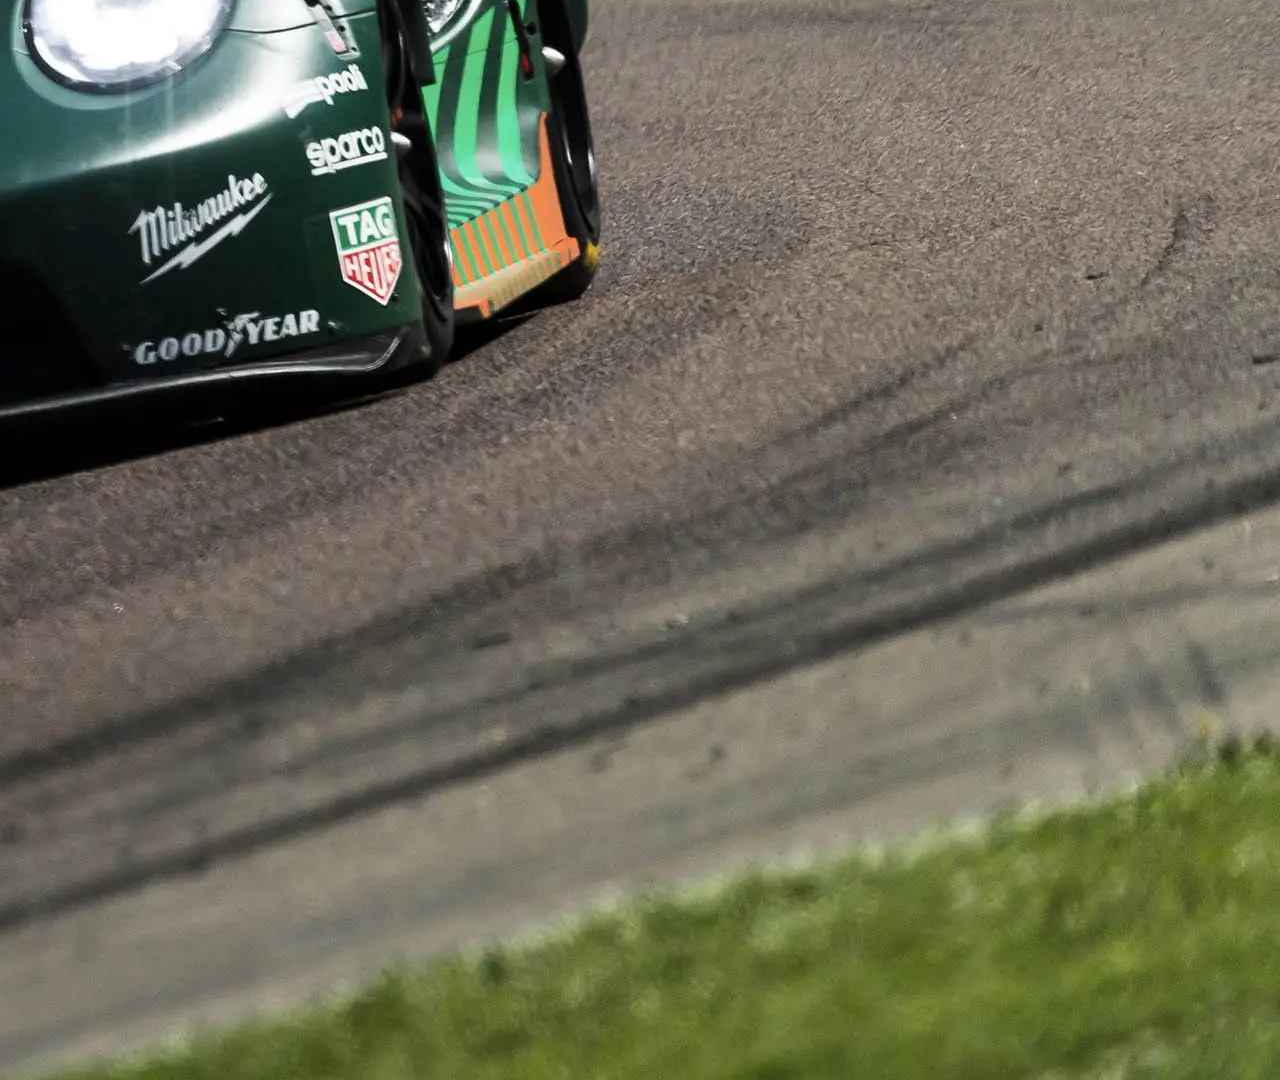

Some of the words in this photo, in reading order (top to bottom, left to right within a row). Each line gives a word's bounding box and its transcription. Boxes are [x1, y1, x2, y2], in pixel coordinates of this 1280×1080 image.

[314, 63, 368, 106] paoli
[306, 126, 385, 172] sparco
[129, 173, 268, 263] Milwaukee
[338, 206, 393, 245] TAG
[344, 243, 400, 296] HEUER
